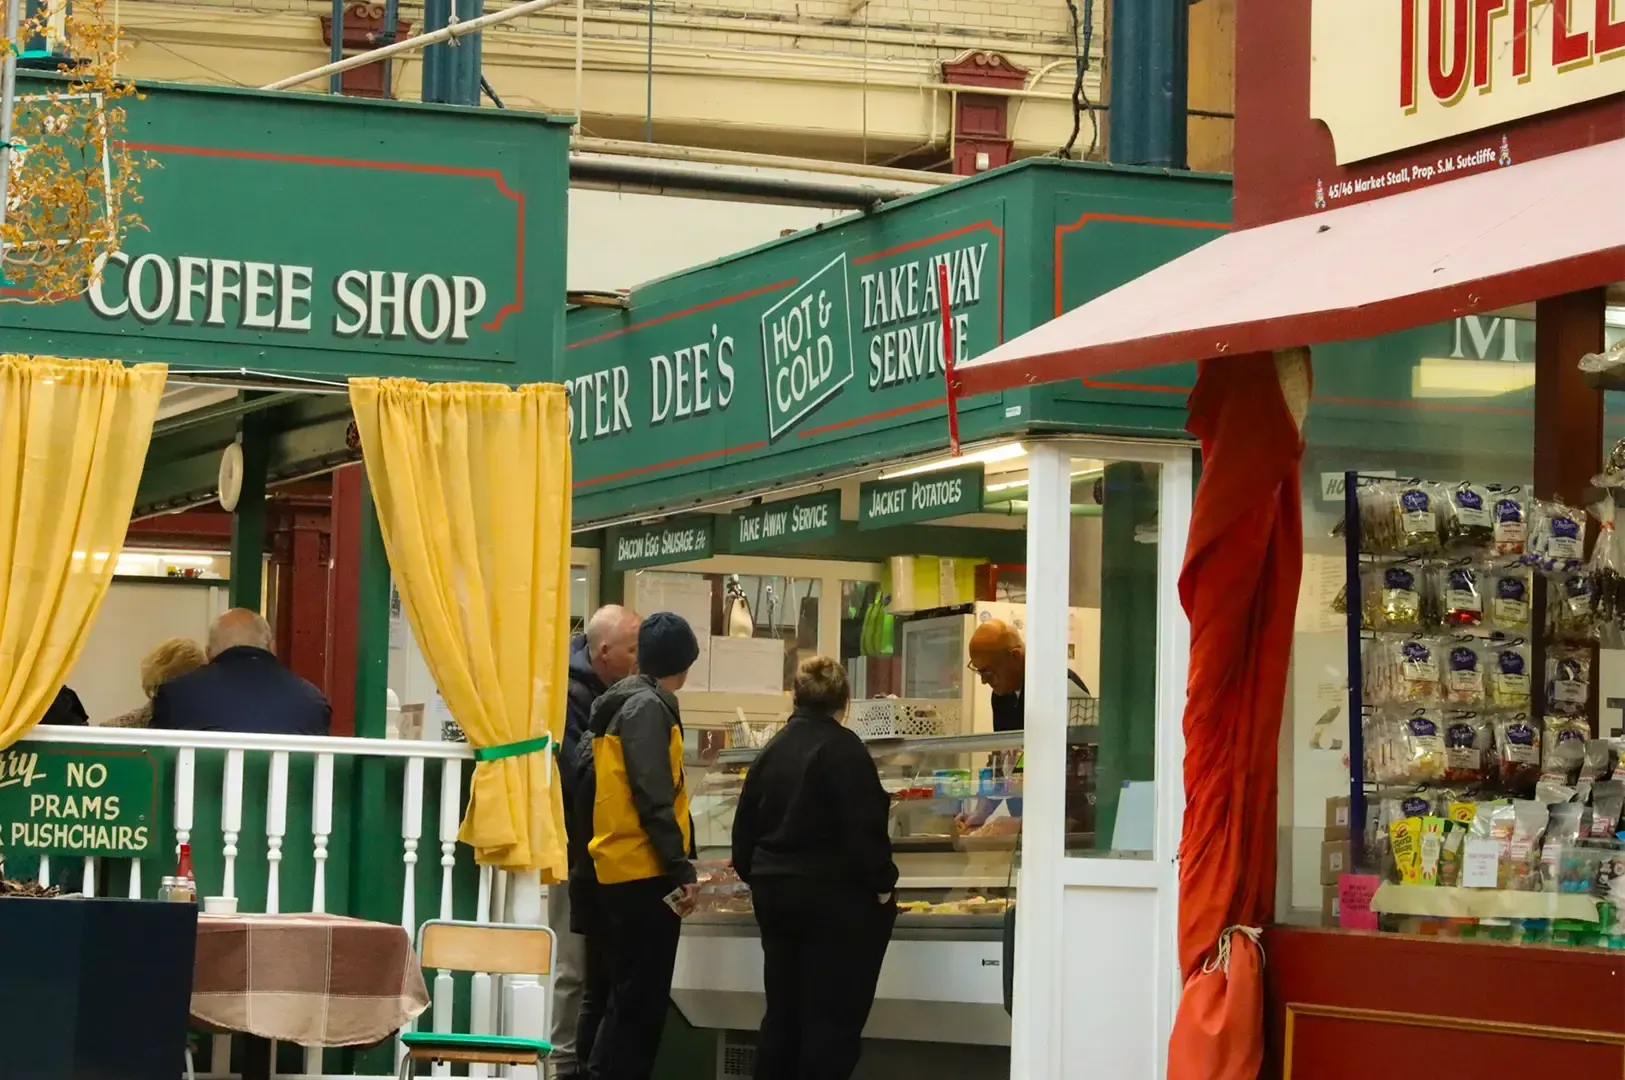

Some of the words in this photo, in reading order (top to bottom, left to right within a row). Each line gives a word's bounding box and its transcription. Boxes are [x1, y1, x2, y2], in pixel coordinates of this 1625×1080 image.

[1329, 181, 1353, 199] 45/46
[1354, 174, 1385, 193] Market
[1387, 168, 1411, 186] Stall,
[1412, 165, 1436, 180] Prop.
[1437, 158, 1455, 173] S.M.
[1457, 148, 1496, 169] Sutcliffe
[88, 251, 313, 332] COFFEE
[334, 268, 487, 341] SHOP
[773, 293, 813, 366] HOT
[818, 289, 832, 329] &
[869, 313, 969, 387] SERVICE
[650, 323, 735, 423] DEE'S
[776, 334, 833, 413] COLD
[869, 488, 906, 518] JACKET
[912, 478, 962, 511] POTATOES
[618, 536, 644, 561] BACON
[644, 532, 660, 557] EGG
[661, 529, 694, 555] SAUSAGE
[739, 515, 760, 543] TAKE
[762, 511, 787, 539] AWAY
[791, 504, 828, 532] SERVICE
[66, 762, 108, 788] NO
[30, 794, 120, 820] PRAMS
[11, 822, 149, 850] PUSHCHAIRS
